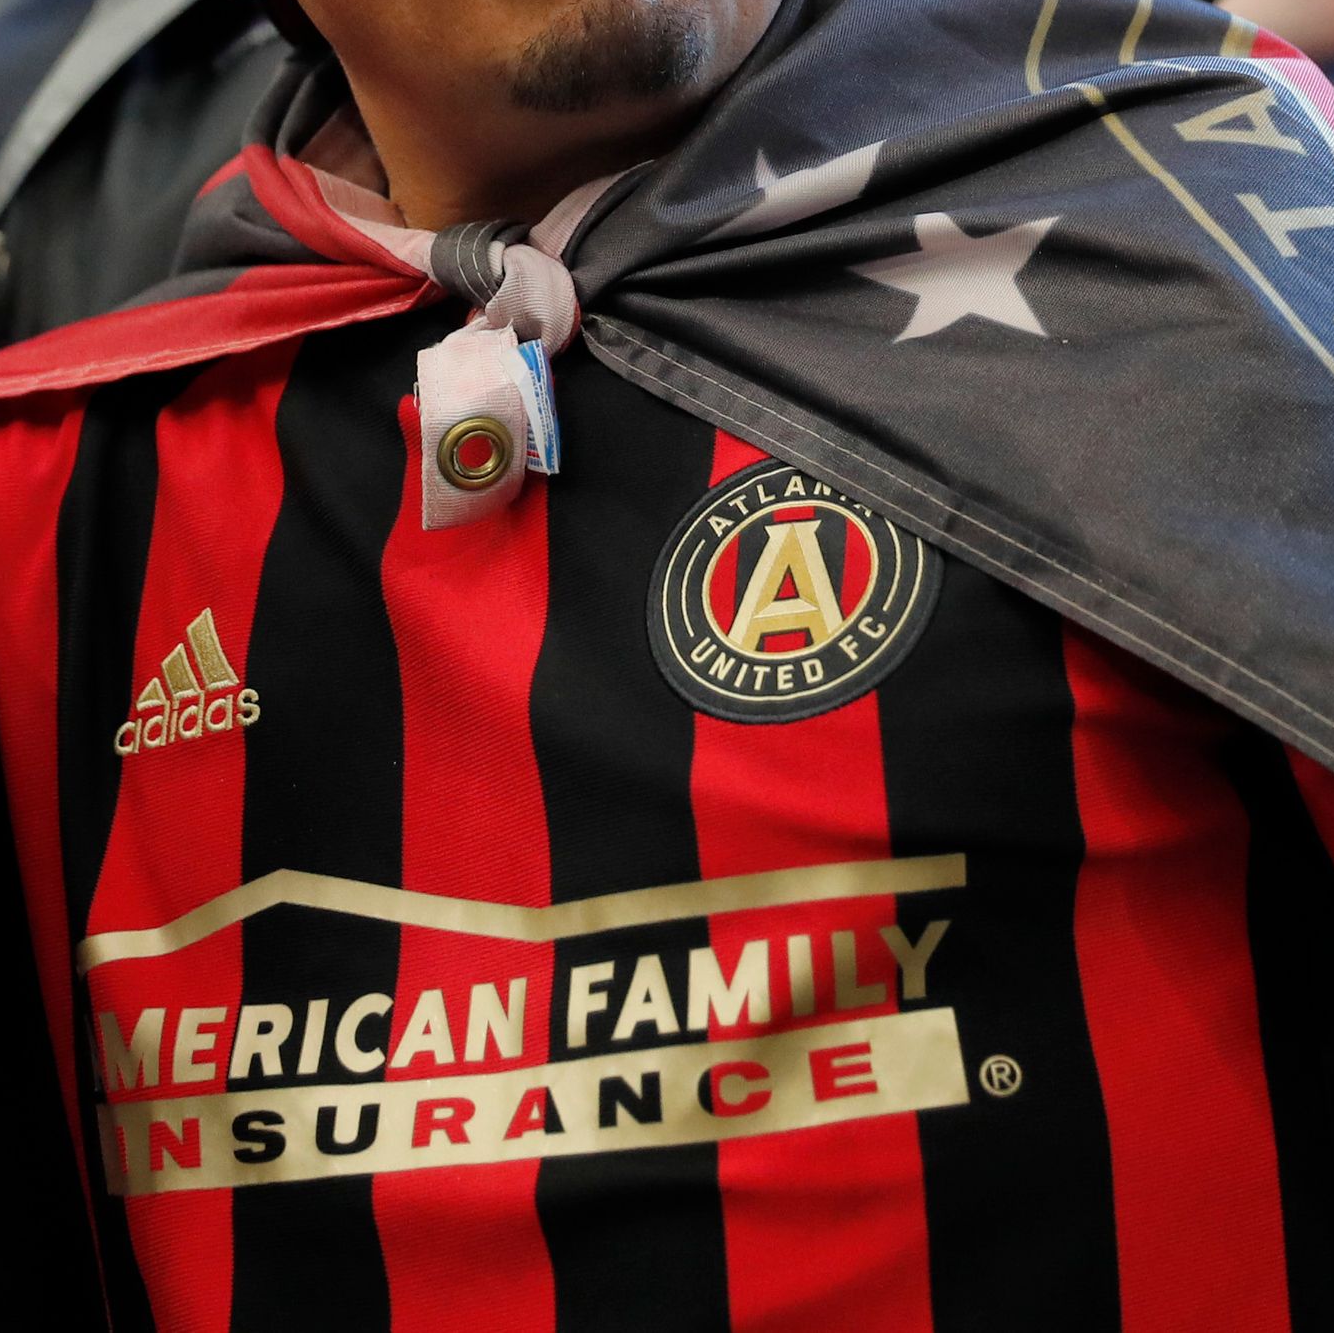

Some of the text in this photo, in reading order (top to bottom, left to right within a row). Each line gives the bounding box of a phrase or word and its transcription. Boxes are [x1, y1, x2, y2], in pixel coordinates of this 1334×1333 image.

[707, 474, 873, 538] ATLAN
[690, 615, 888, 692] UNITED FC
[114, 688, 261, 756] adidas
[567, 920, 953, 1049] FAMILY
[115, 1041, 879, 1175] INSURANCE
